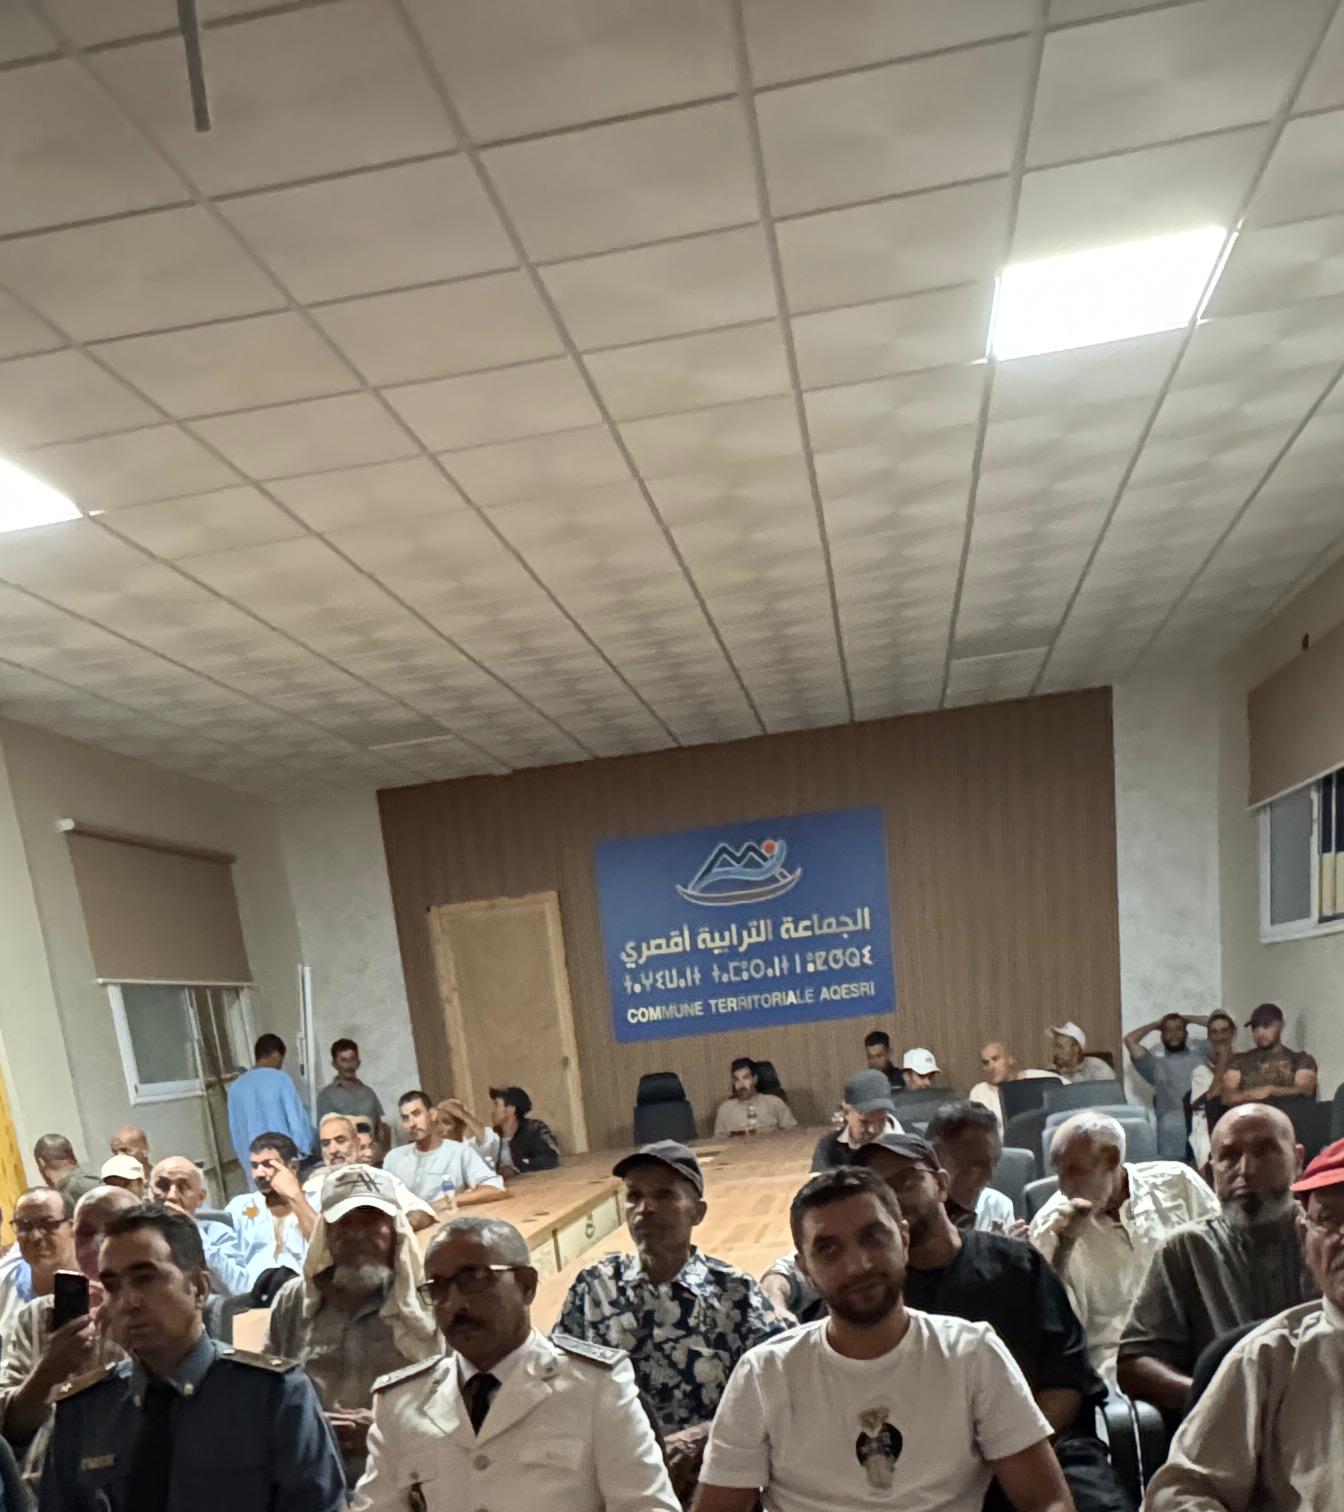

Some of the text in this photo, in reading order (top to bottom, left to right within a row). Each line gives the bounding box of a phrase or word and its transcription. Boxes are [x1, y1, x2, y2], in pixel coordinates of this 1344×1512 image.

[697, 918, 773, 953] الترابية
[780, 906, 870, 939] الجماعة
[627, 981, 875, 1024] COMMUNE TERRITORIALE AQESRI
